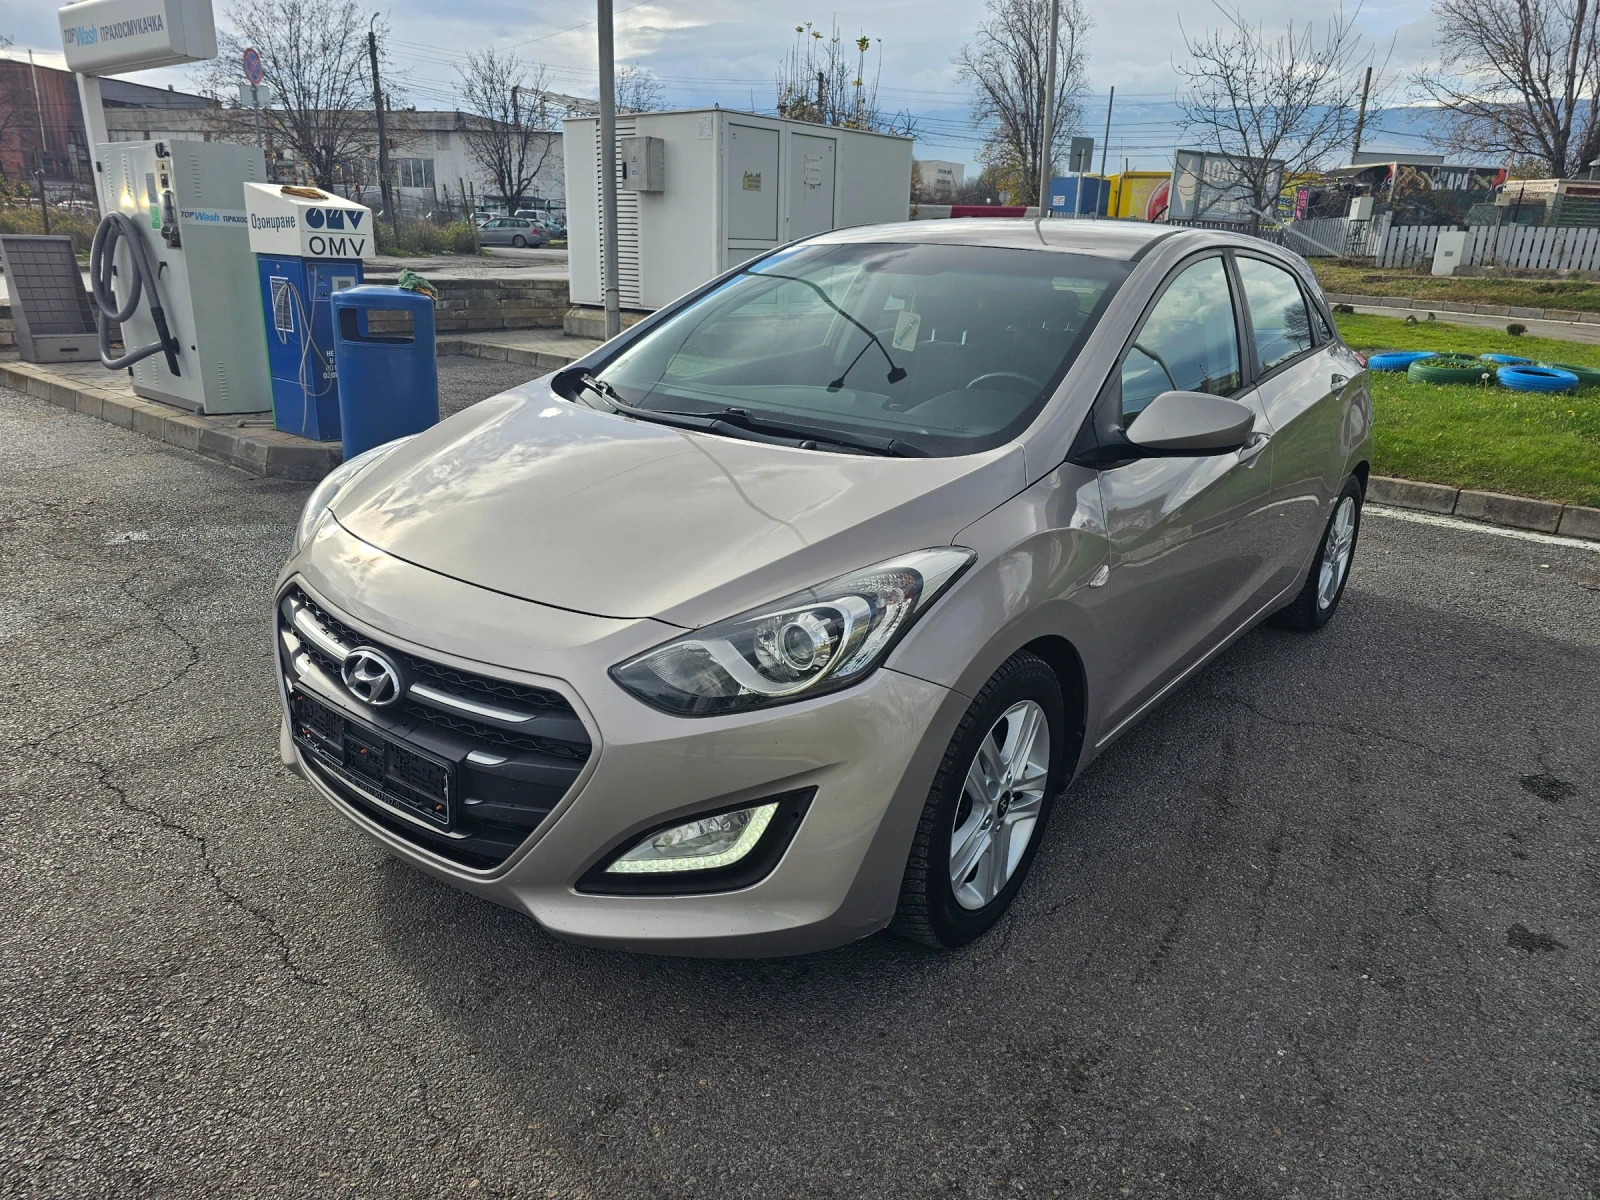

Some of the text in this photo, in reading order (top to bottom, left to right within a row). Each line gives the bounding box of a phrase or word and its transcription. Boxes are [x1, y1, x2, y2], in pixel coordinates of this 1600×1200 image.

[100, 14, 164, 42] ПРАХОСМУКАЧКА
[251, 213, 296, 233] Озониране
[309, 236, 365, 257] OMV
